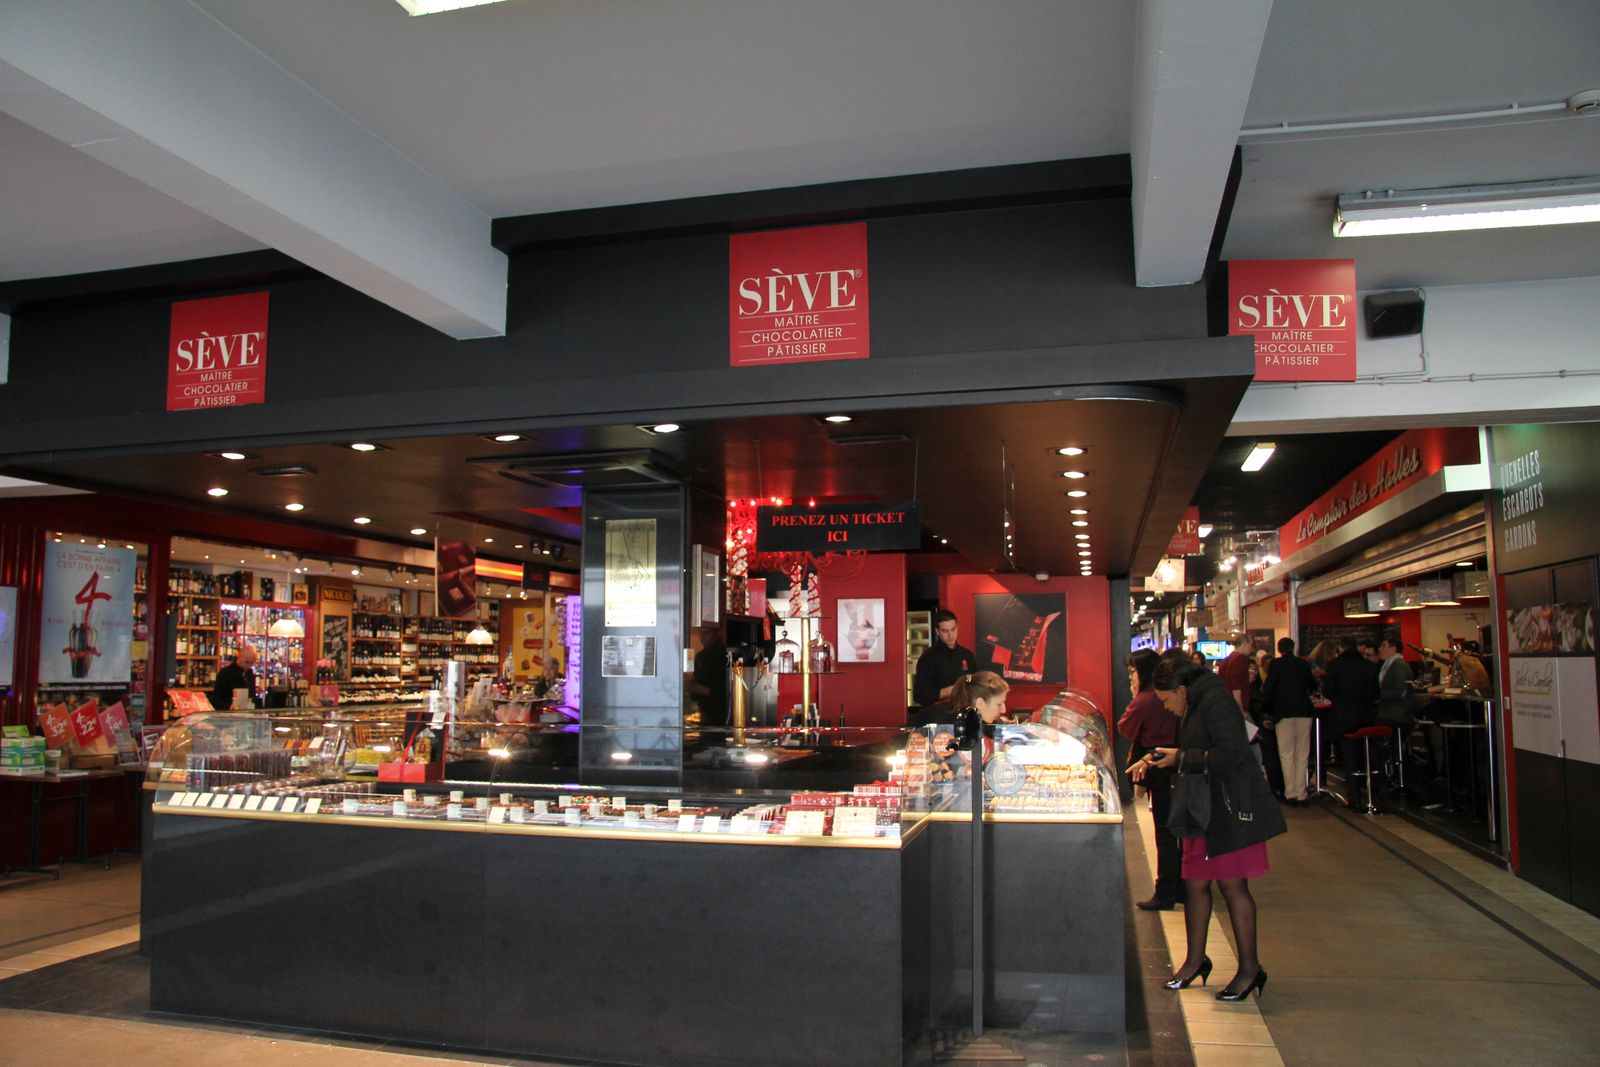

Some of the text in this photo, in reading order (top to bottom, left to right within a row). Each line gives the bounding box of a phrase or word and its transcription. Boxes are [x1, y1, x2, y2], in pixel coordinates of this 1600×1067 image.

[739, 268, 856, 315] SÈVE
[1239, 288, 1346, 328] SÈVE
[774, 314, 819, 327] MAÎTRE
[752, 327, 842, 343] CHOCOLATIER
[1271, 330, 1313, 341] MAÎTRE
[176, 331, 260, 372] SÈVE
[768, 342, 826, 356] PÂTISSIER
[1265, 355, 1319, 366] PÂTISSIER
[200, 371, 233, 382] MAÎTRE
[184, 381, 248, 396] CHOCOLATIER
[194, 395, 236, 407] PÂTISSIER
[1500, 449, 1540, 494] QUENELLES
[1307, 499, 1348, 537] Comptoir
[1349, 480, 1368, 511] des
[1370, 445, 1419, 498] Halles
[1502, 481, 1544, 521] ESCARGOTS
[772, 511, 906, 526] PRENEZ UN TICKET
[827, 530, 848, 542] ICI
